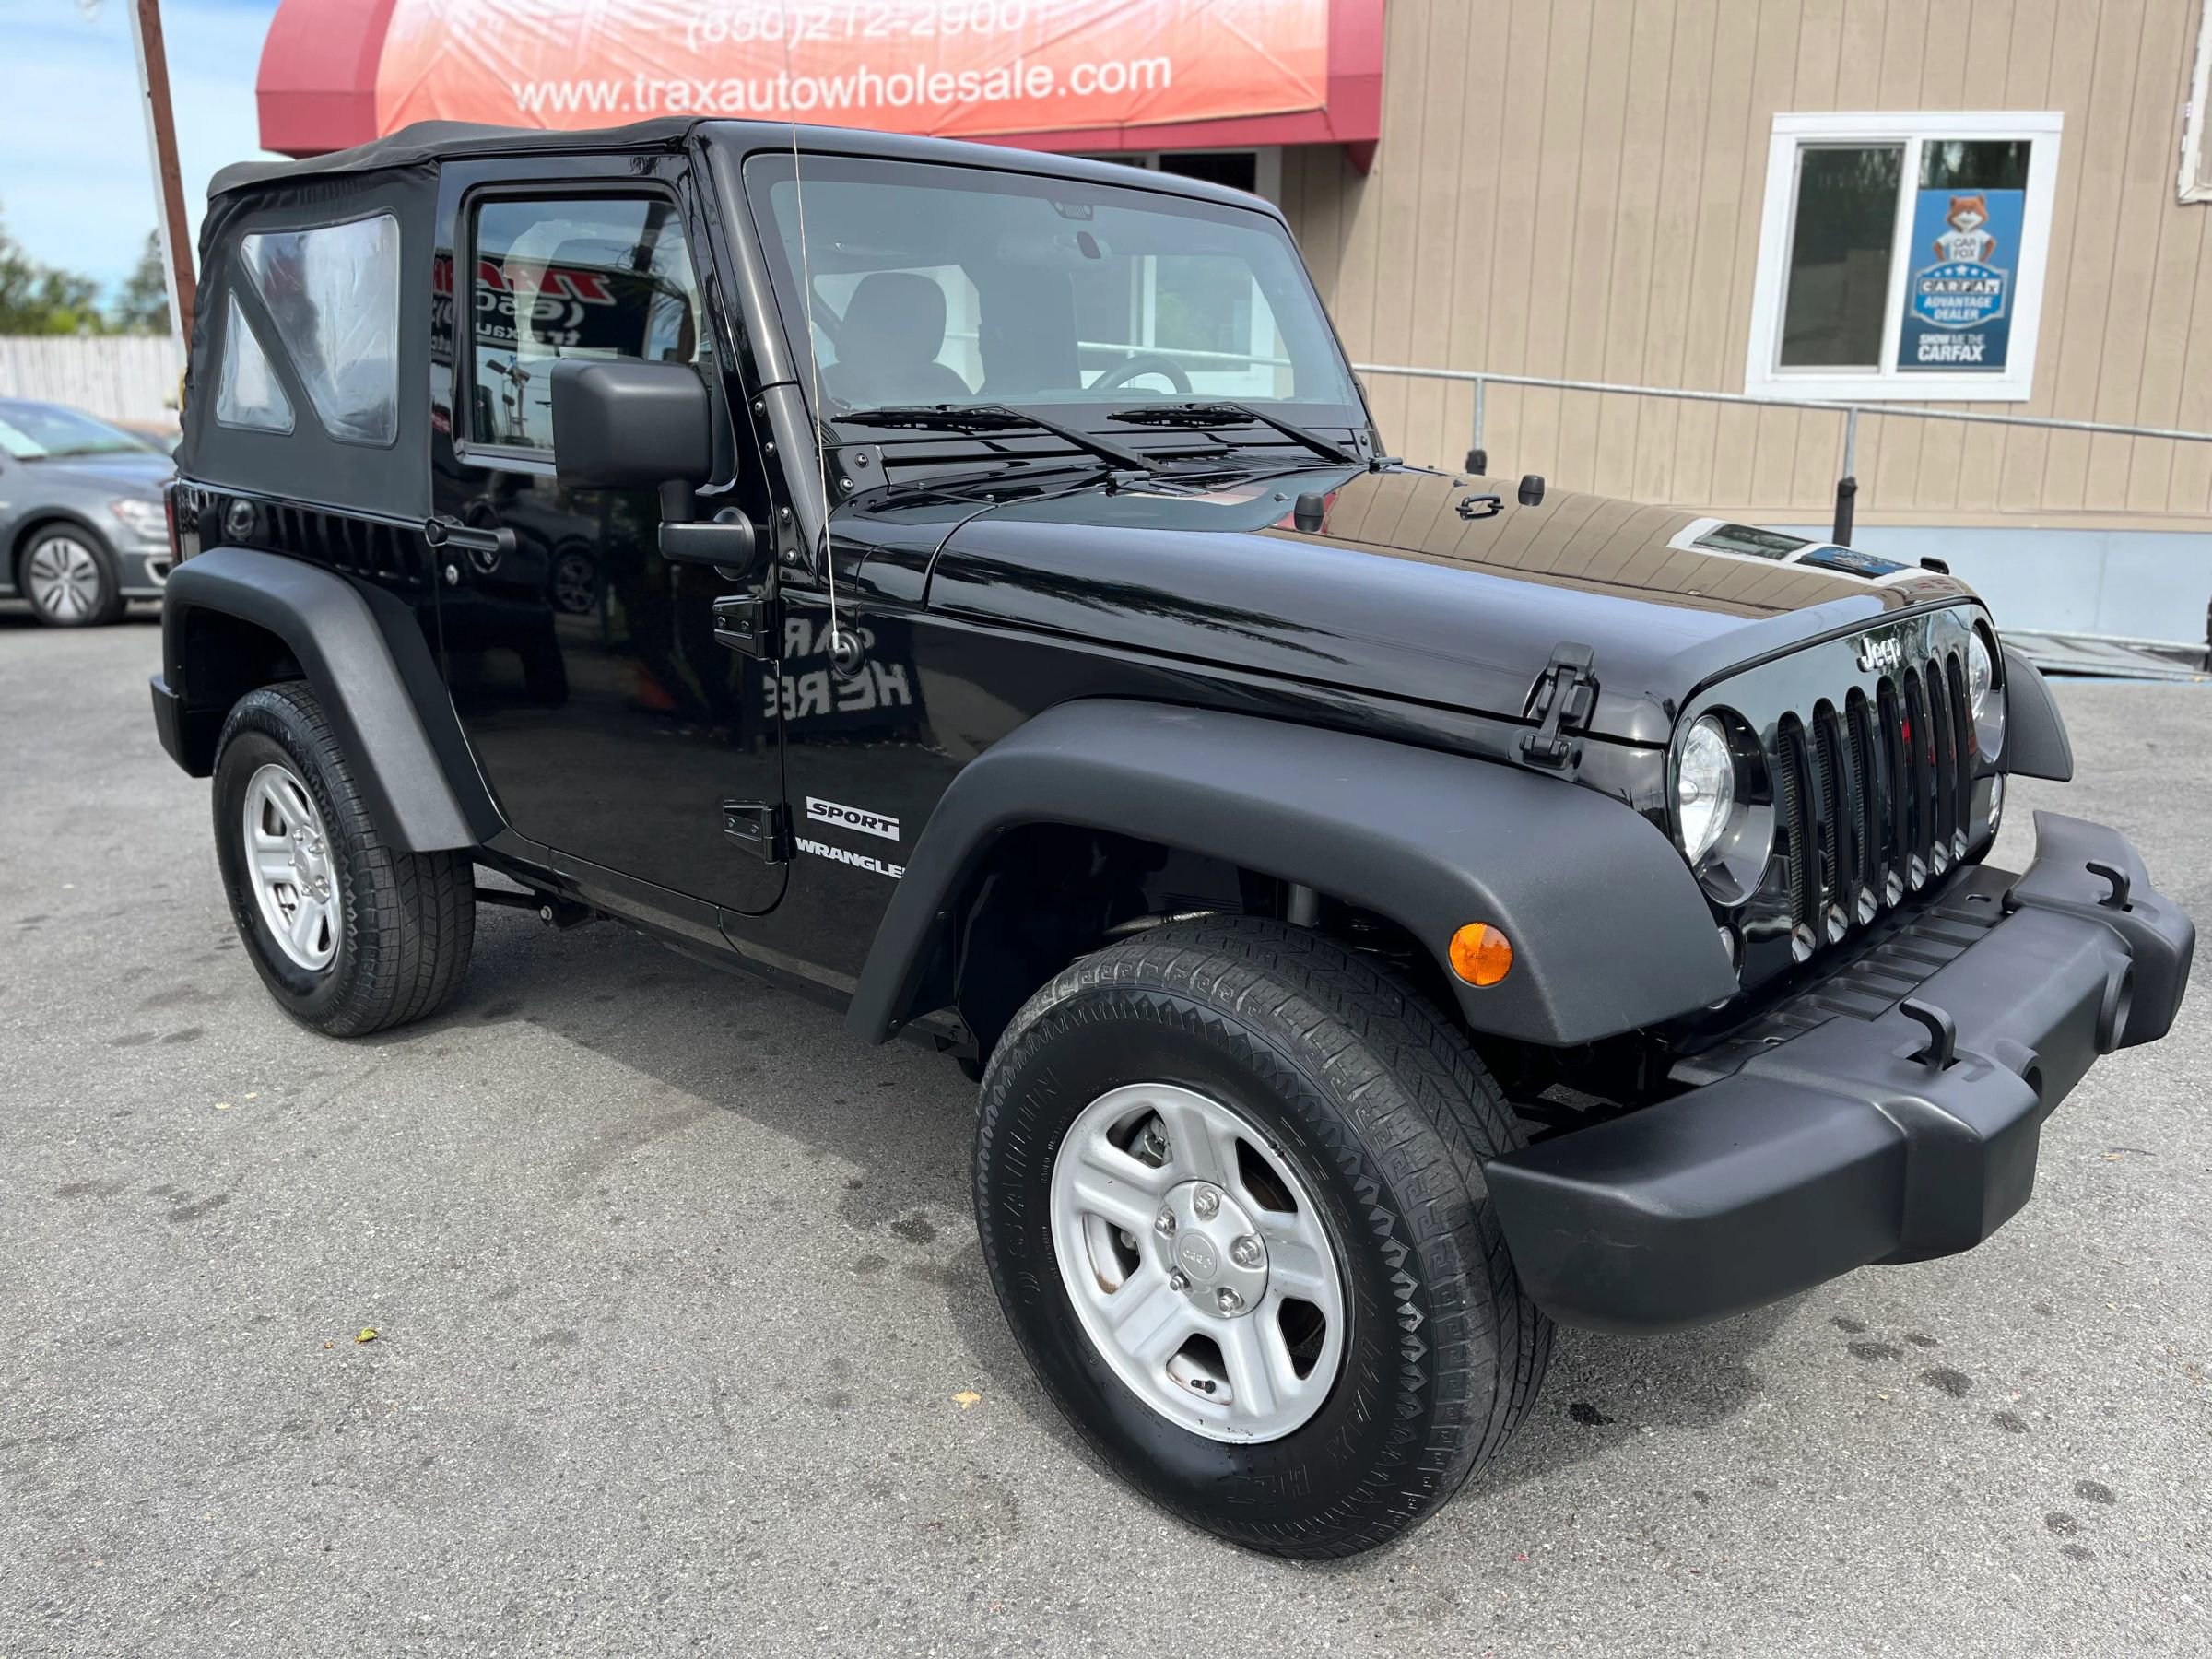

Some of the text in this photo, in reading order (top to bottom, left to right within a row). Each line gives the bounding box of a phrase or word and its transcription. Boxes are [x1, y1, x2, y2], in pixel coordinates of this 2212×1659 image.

[512, 55, 1171, 112] www.traxautowholesale.com
[1954, 237, 1976, 247] CAR
[1954, 249, 1975, 259] FOX
[1920, 279, 1999, 294] CARFAX
[1924, 296, 1991, 308] ADVANTAGE
[1934, 309, 1979, 320] DEALER
[1919, 334, 1949, 344] SHOW
[1967, 334, 1985, 344] THE
[1918, 346, 1983, 361] CARFAX
[1857, 637, 1901, 673] Jeep
[807, 799, 900, 835] SPORT
[796, 836, 906, 880] WRANGLE
